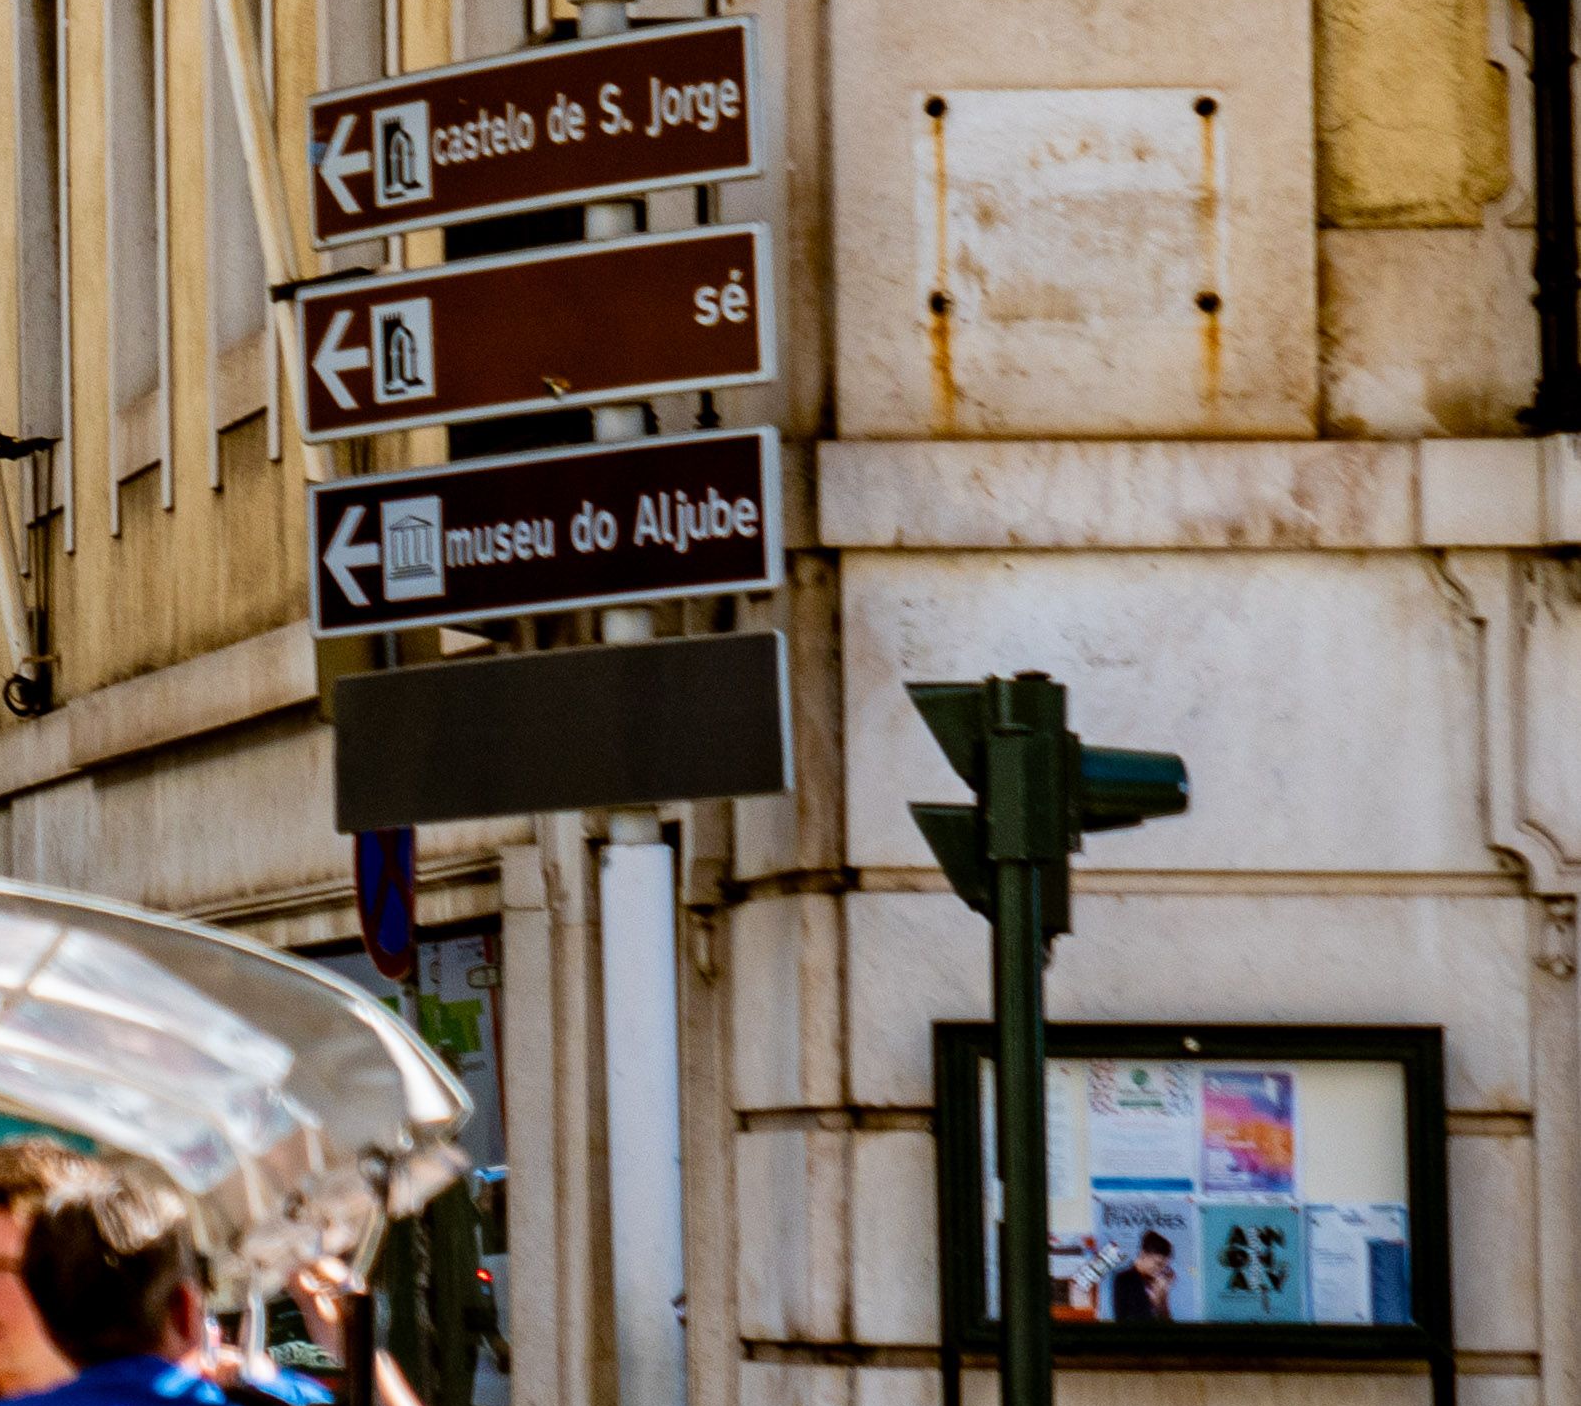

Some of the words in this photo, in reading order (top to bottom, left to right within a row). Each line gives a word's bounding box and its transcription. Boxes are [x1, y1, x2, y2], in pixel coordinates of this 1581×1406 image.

[432, 101, 536, 166] castelo
[547, 92, 587, 144] de
[599, 82, 634, 135] S.
[645, 76, 742, 138] Jorge
[693, 267, 751, 326] sé
[444, 517, 556, 568] museu
[570, 499, 619, 553] do
[633, 486, 759, 555] Aljube
